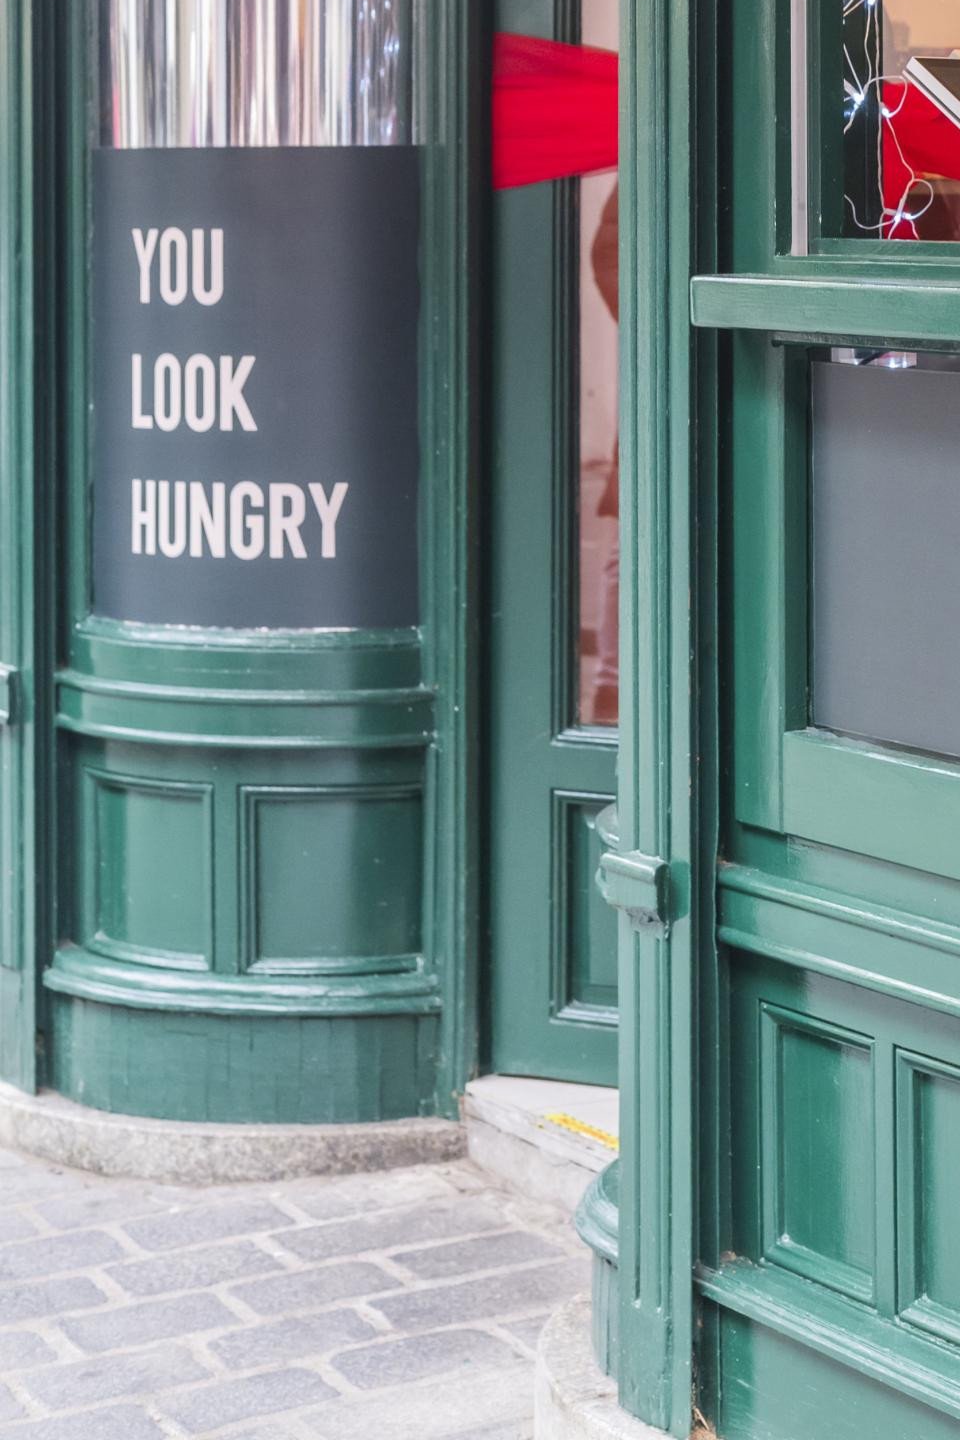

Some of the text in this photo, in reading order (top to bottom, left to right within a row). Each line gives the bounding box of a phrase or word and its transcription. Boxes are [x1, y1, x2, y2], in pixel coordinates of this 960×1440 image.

[131, 227, 224, 306] YOU
[131, 353, 258, 432] LOOK
[131, 479, 349, 560] HUNGRY
